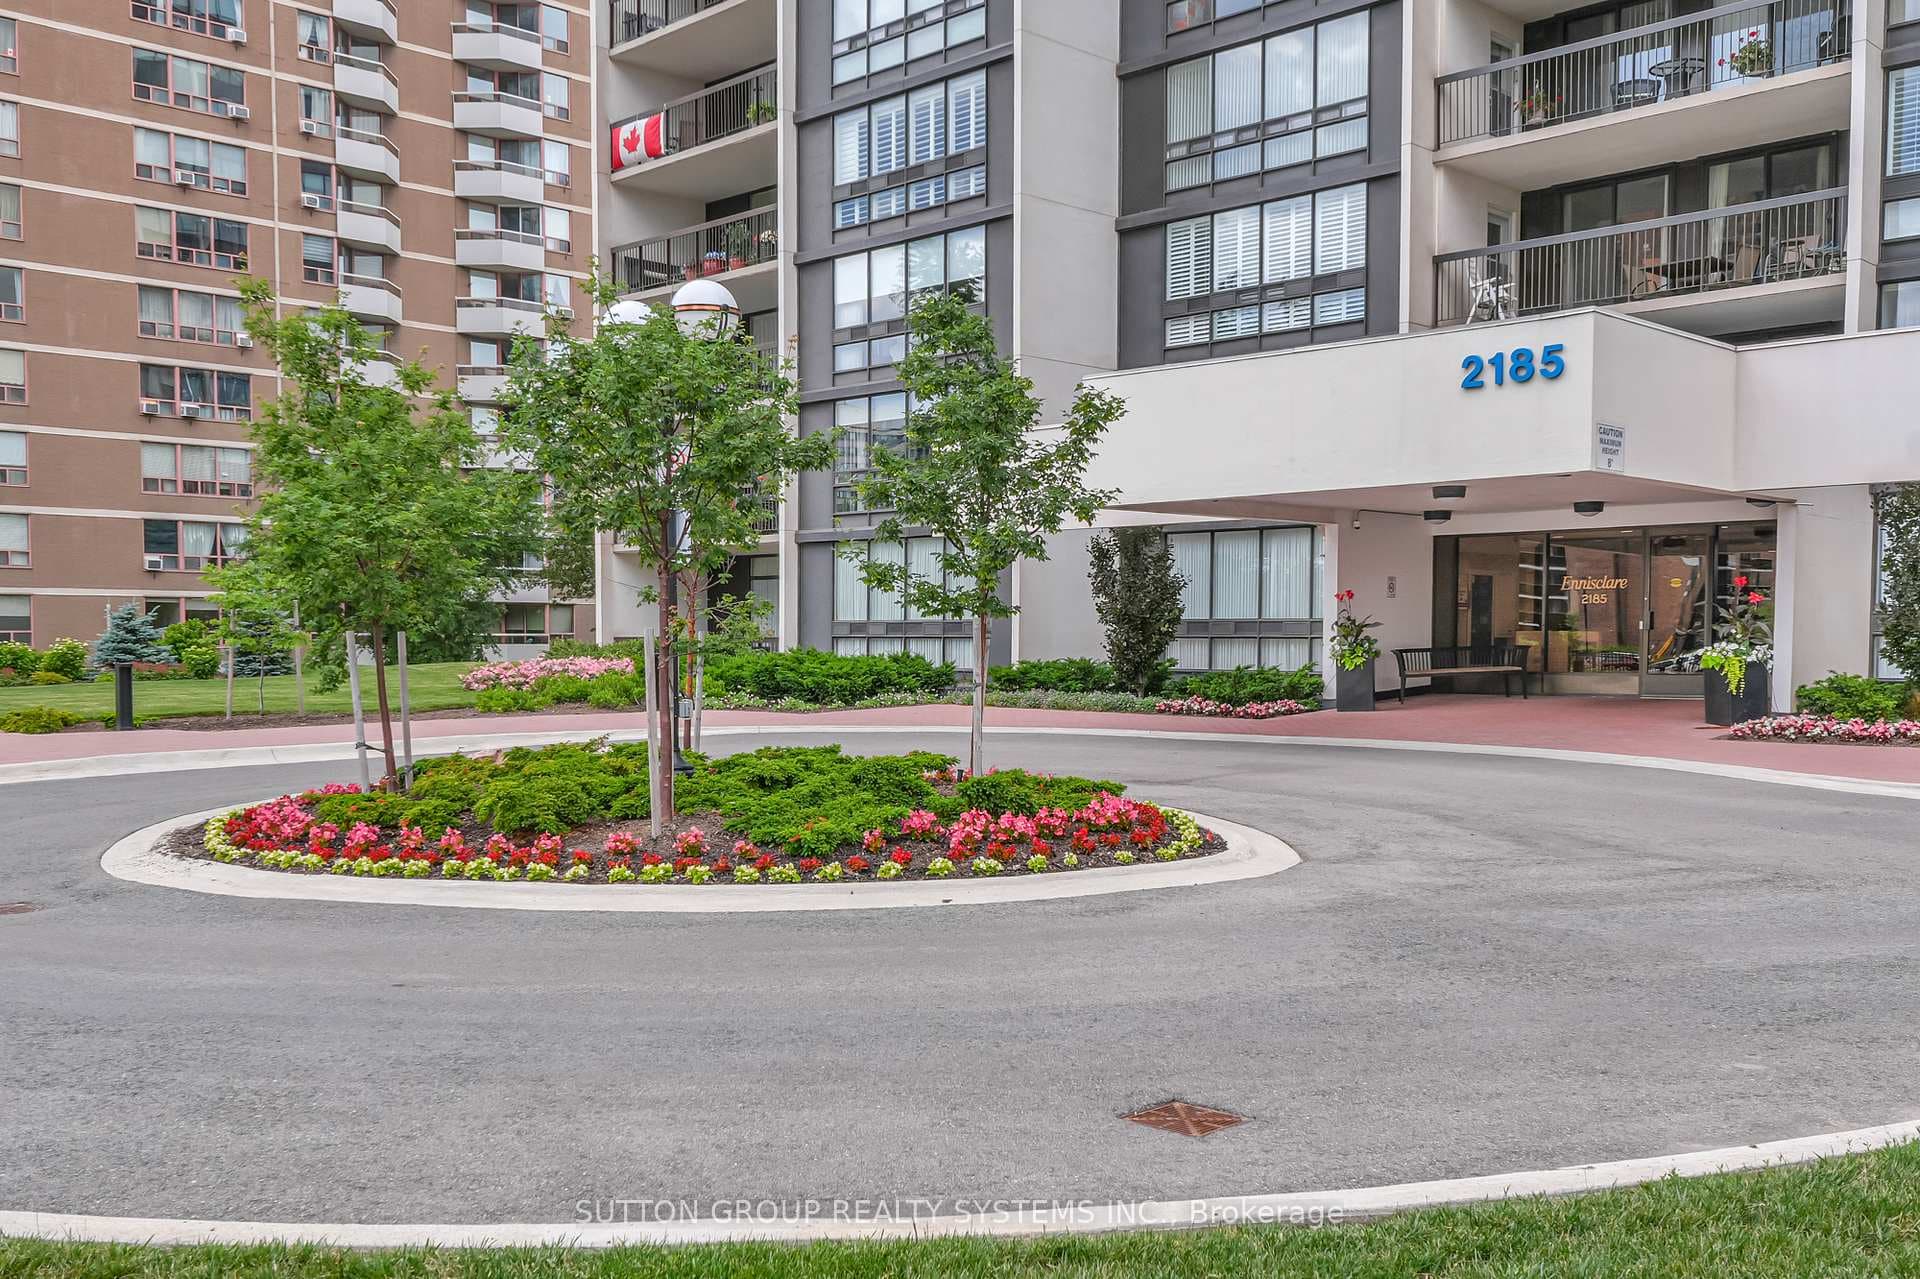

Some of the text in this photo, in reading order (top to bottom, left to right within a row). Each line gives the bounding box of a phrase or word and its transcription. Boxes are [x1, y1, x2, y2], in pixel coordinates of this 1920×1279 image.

[1461, 343, 1565, 389] 2185
[1599, 426, 1623, 438] CAUTION
[1561, 575, 1628, 590] Ennisclare
[1581, 593, 1607, 604] 2185
